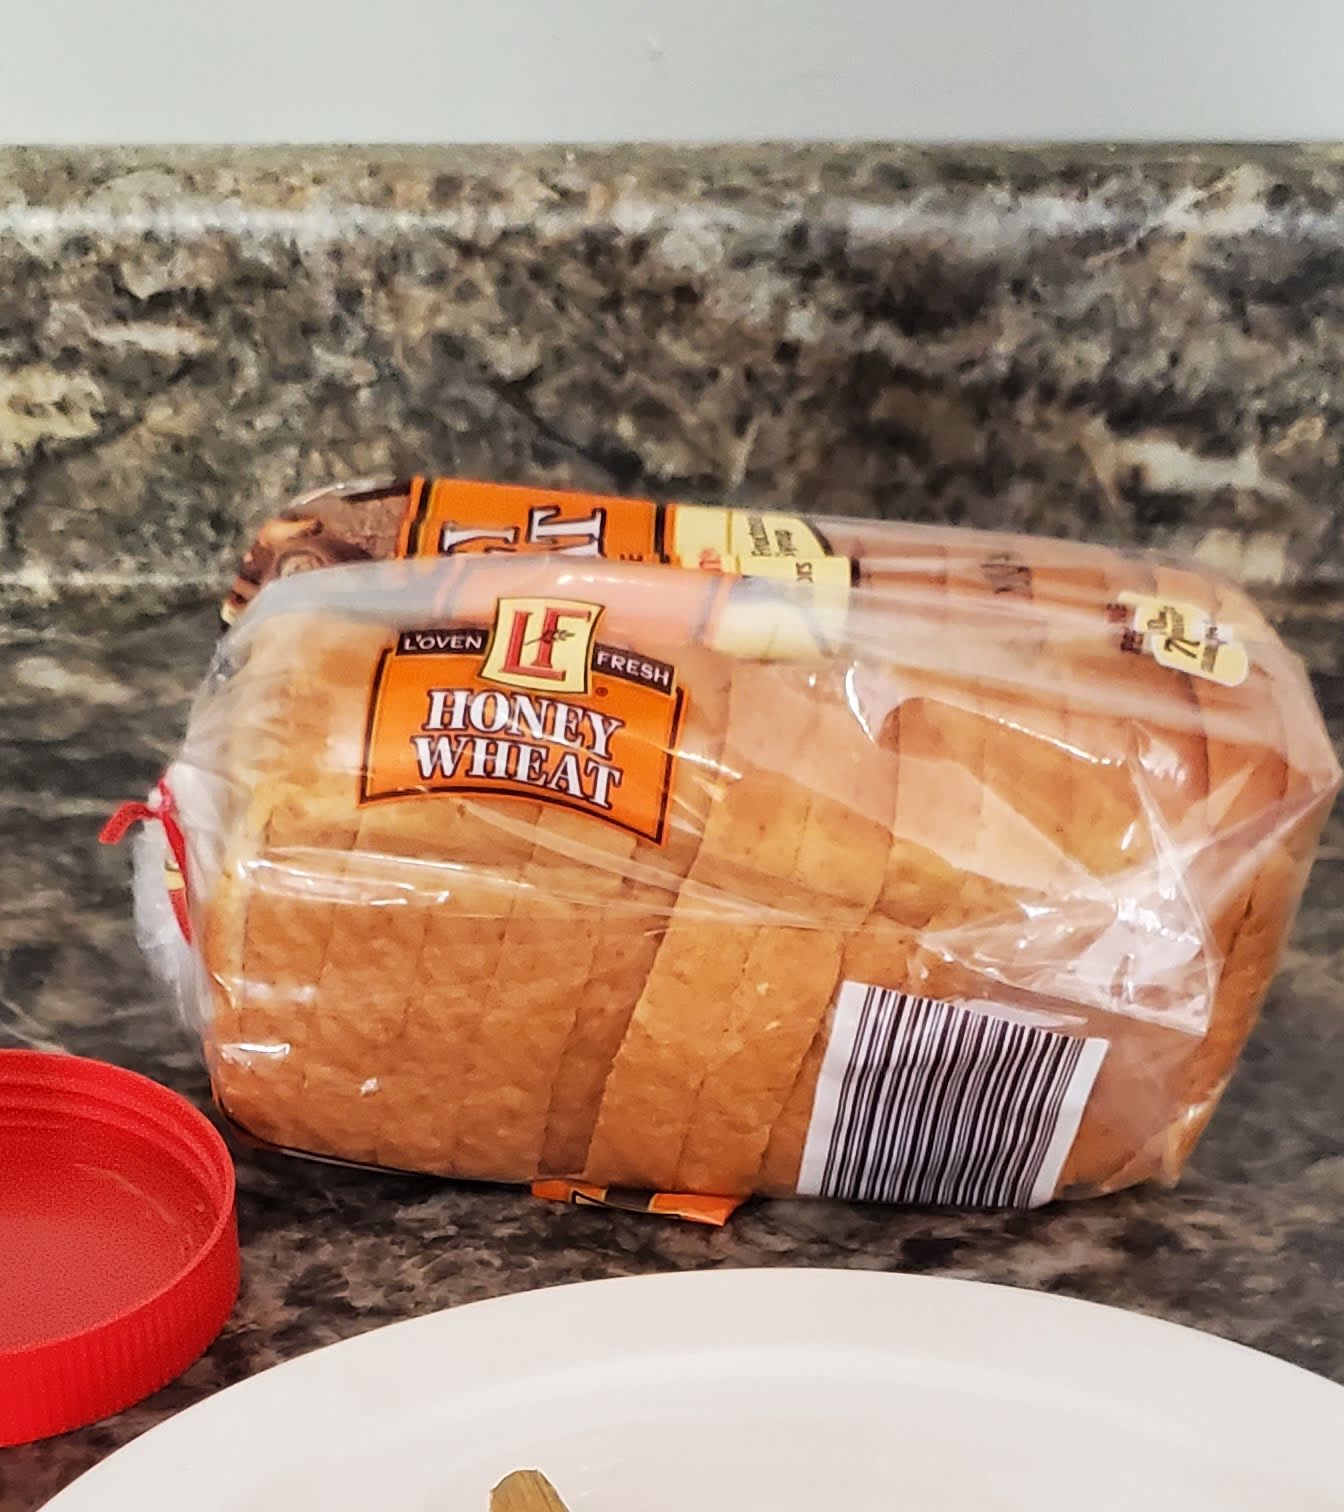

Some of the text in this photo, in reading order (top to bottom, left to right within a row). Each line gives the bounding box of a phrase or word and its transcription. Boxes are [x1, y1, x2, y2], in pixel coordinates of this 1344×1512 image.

[405, 633, 483, 651] L'OVEN
[597, 649, 669, 687] FRESH
[423, 688, 625, 760] HONEY
[412, 735, 622, 809] WHEAT
